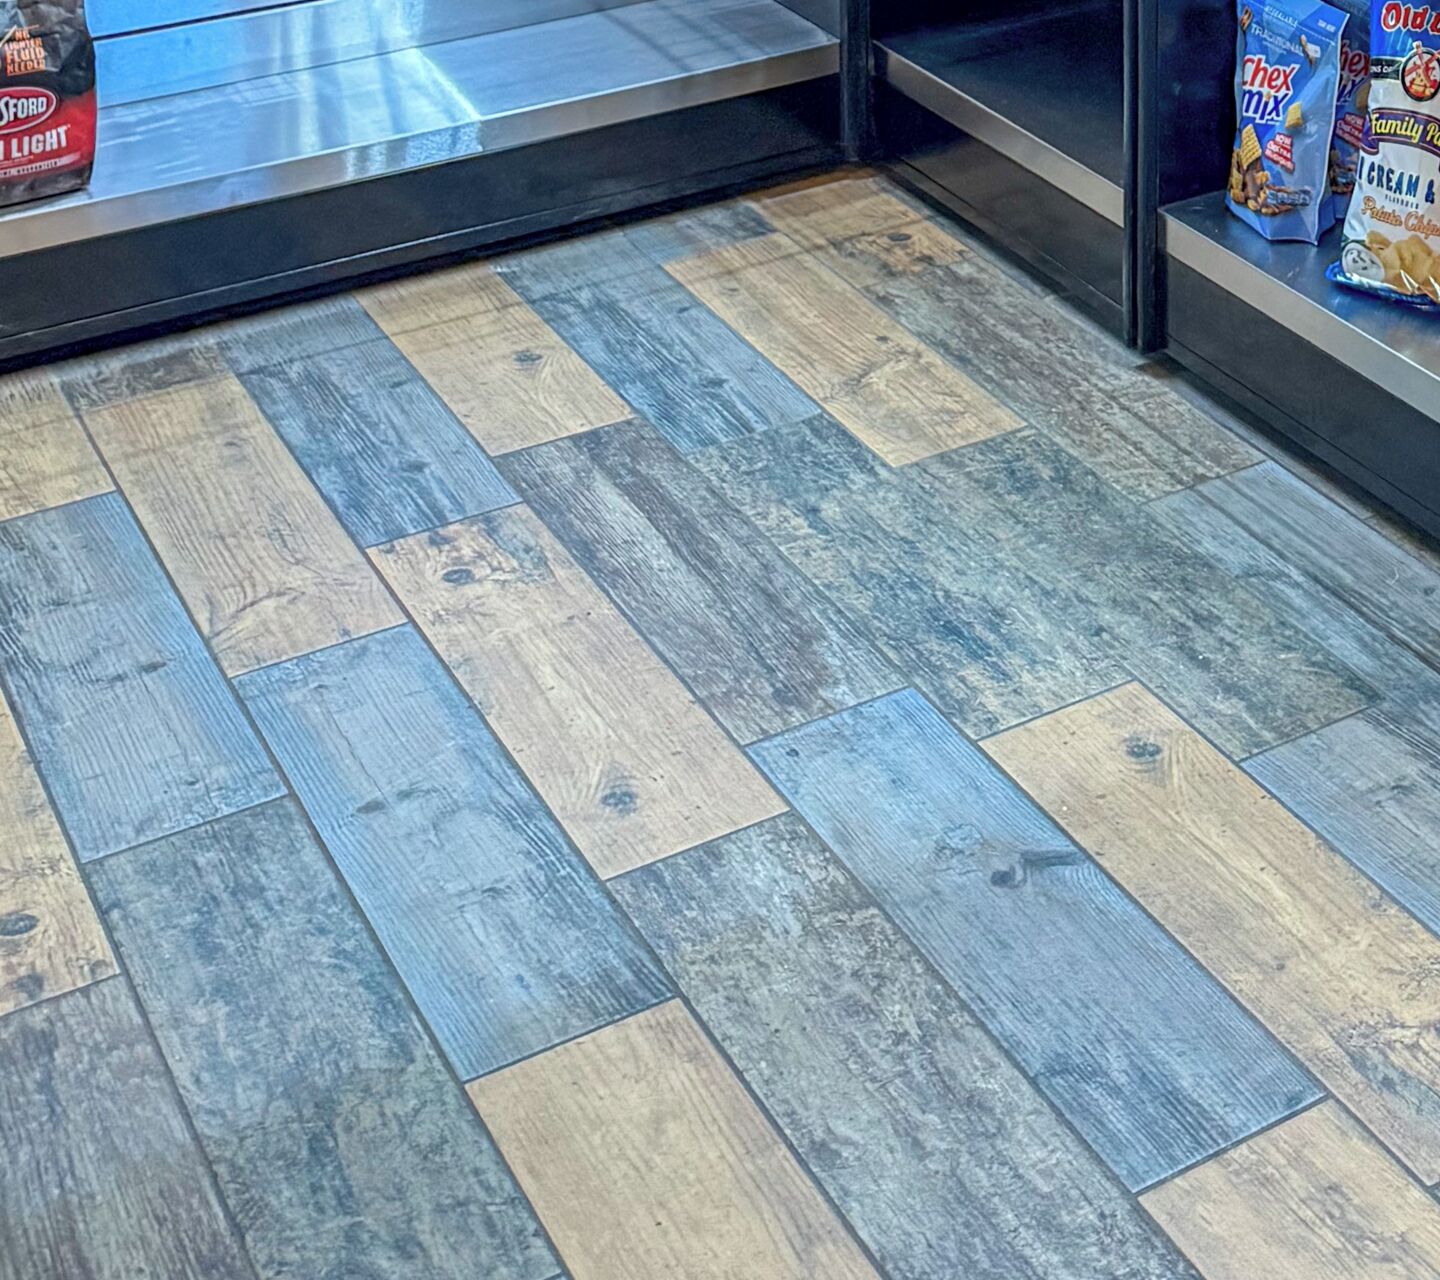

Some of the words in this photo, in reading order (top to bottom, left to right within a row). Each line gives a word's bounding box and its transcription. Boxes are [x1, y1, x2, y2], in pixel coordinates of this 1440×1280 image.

[1382, 1, 1426, 32] Old
[6, 47, 46, 63] FLUID
[1242, 55, 1298, 93] Chex
[0, 95, 48, 125] SFORD
[1242, 90, 1290, 122] mix
[11, 127, 69, 159] LIGHT
[1371, 114, 1423, 142] Family
[1367, 160, 1421, 198] CREAM
[1425, 179, 1435, 204] &
[1361, 195, 1403, 227] Potato
